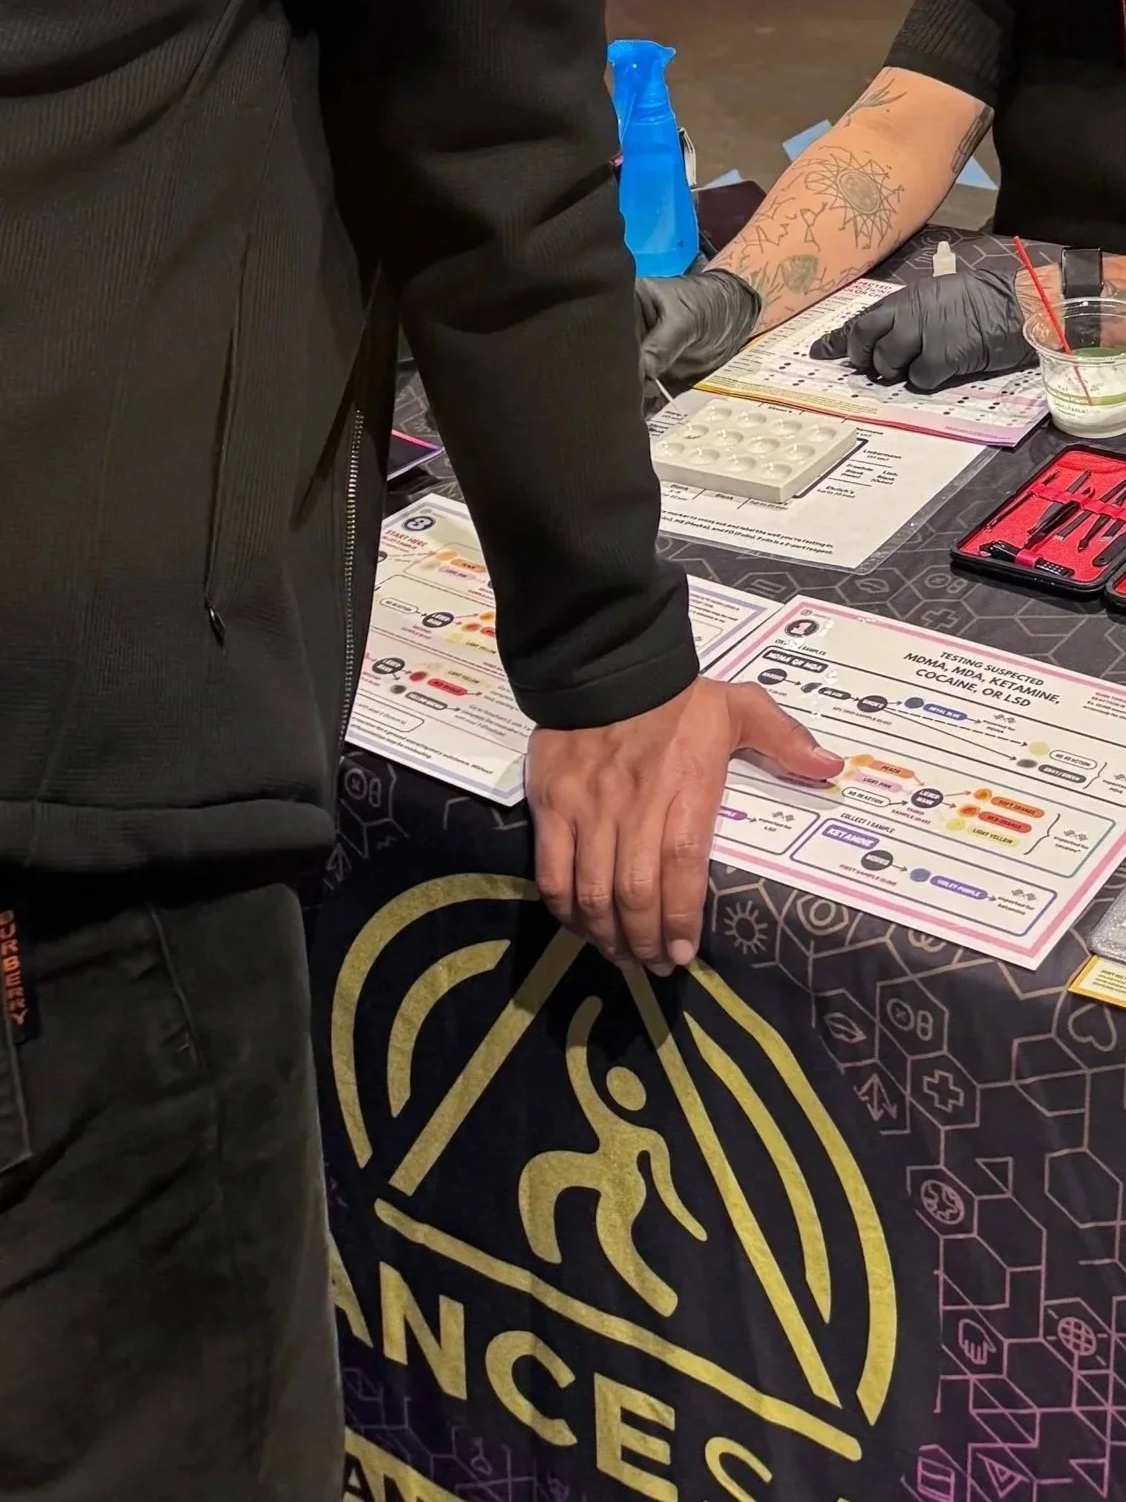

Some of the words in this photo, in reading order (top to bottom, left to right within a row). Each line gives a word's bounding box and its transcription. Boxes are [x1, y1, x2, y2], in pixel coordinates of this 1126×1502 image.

[904, 652, 949, 672] MDMA,
[951, 666, 985, 683] MDA,
[989, 676, 1060, 705] KETAMINE,
[940, 651, 983, 668] TESTING
[984, 664, 1044, 686] SUSPECTED
[916, 669, 977, 693] COCAINE,
[982, 686, 1002, 699] OR
[1003, 694, 1031, 708] LSD
[827, 827, 876, 846] KETAMINE
